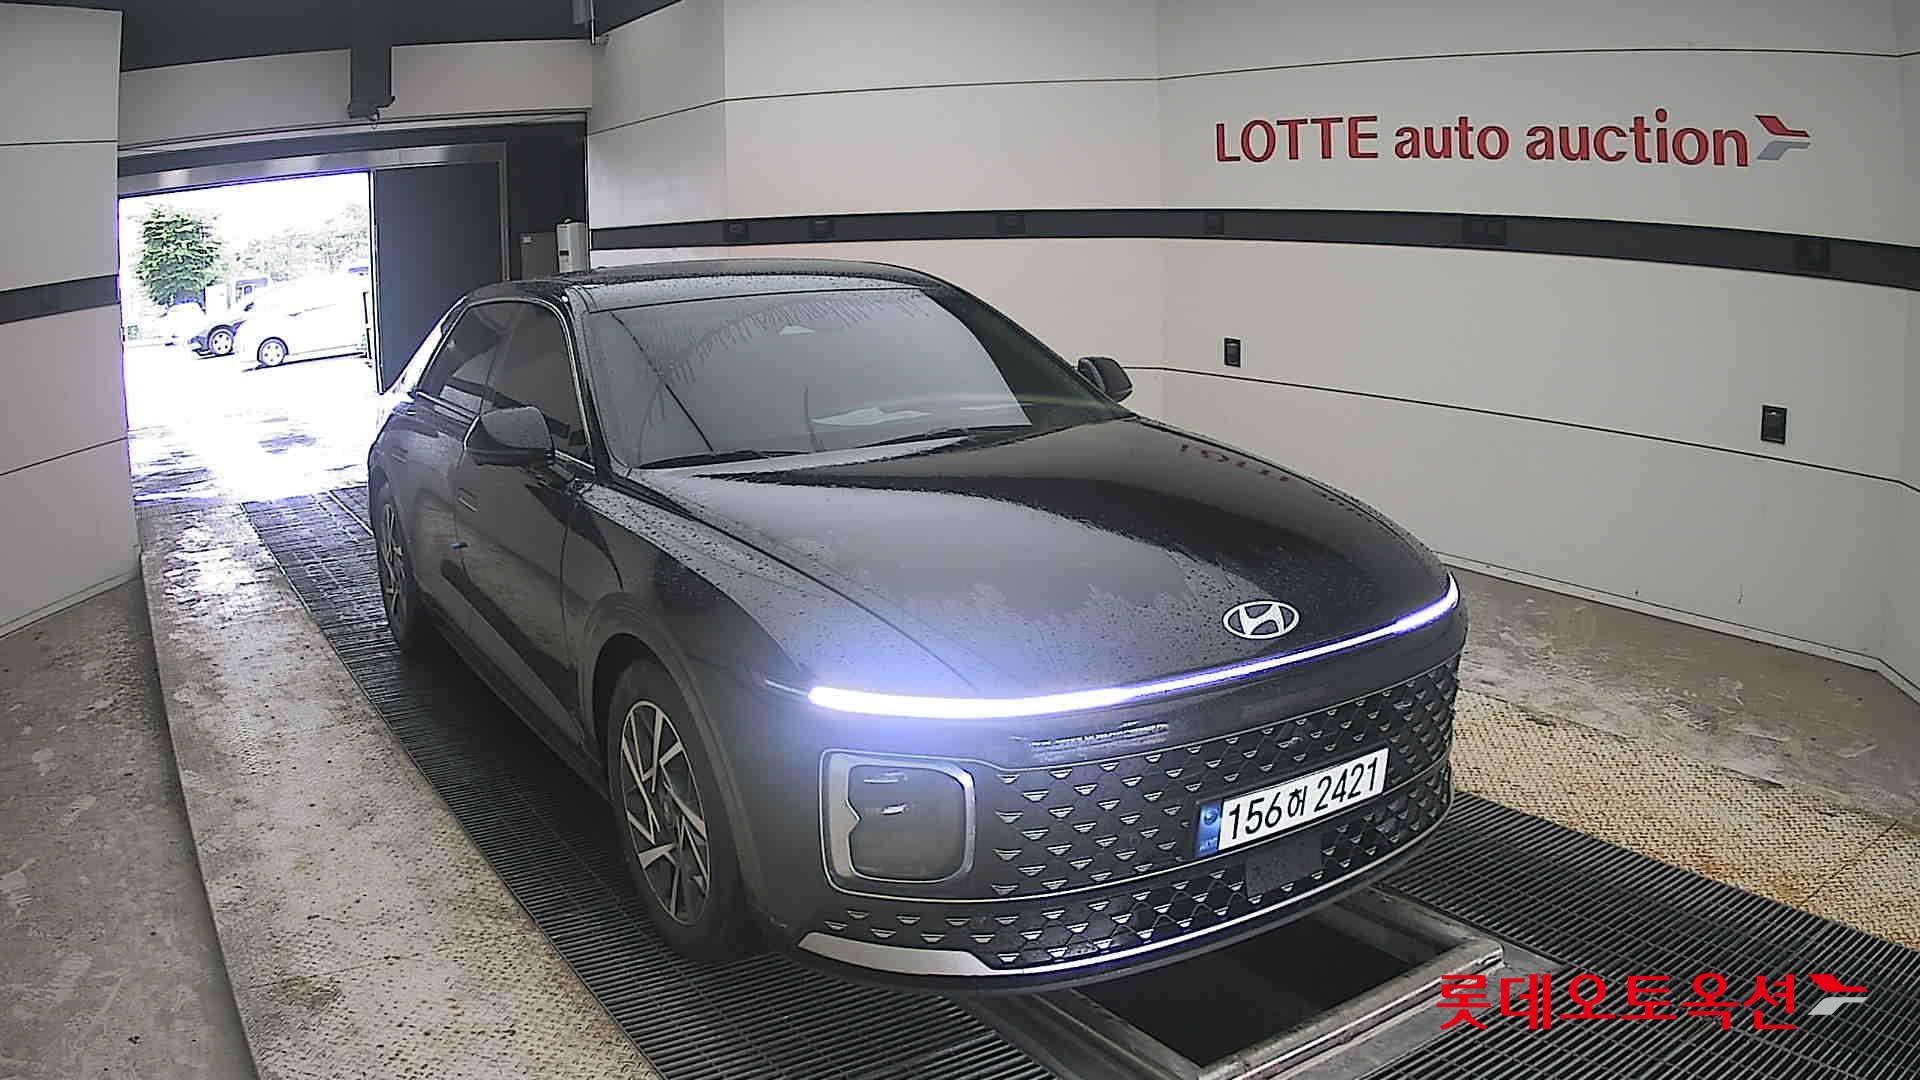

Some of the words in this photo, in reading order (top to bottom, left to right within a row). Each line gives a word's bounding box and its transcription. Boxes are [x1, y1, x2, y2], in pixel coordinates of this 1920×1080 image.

[1215, 116, 1378, 162] LOTTE
[1395, 116, 1511, 161] auto
[1527, 109, 1749, 167] auction
[1314, 757, 1378, 813] 2421
